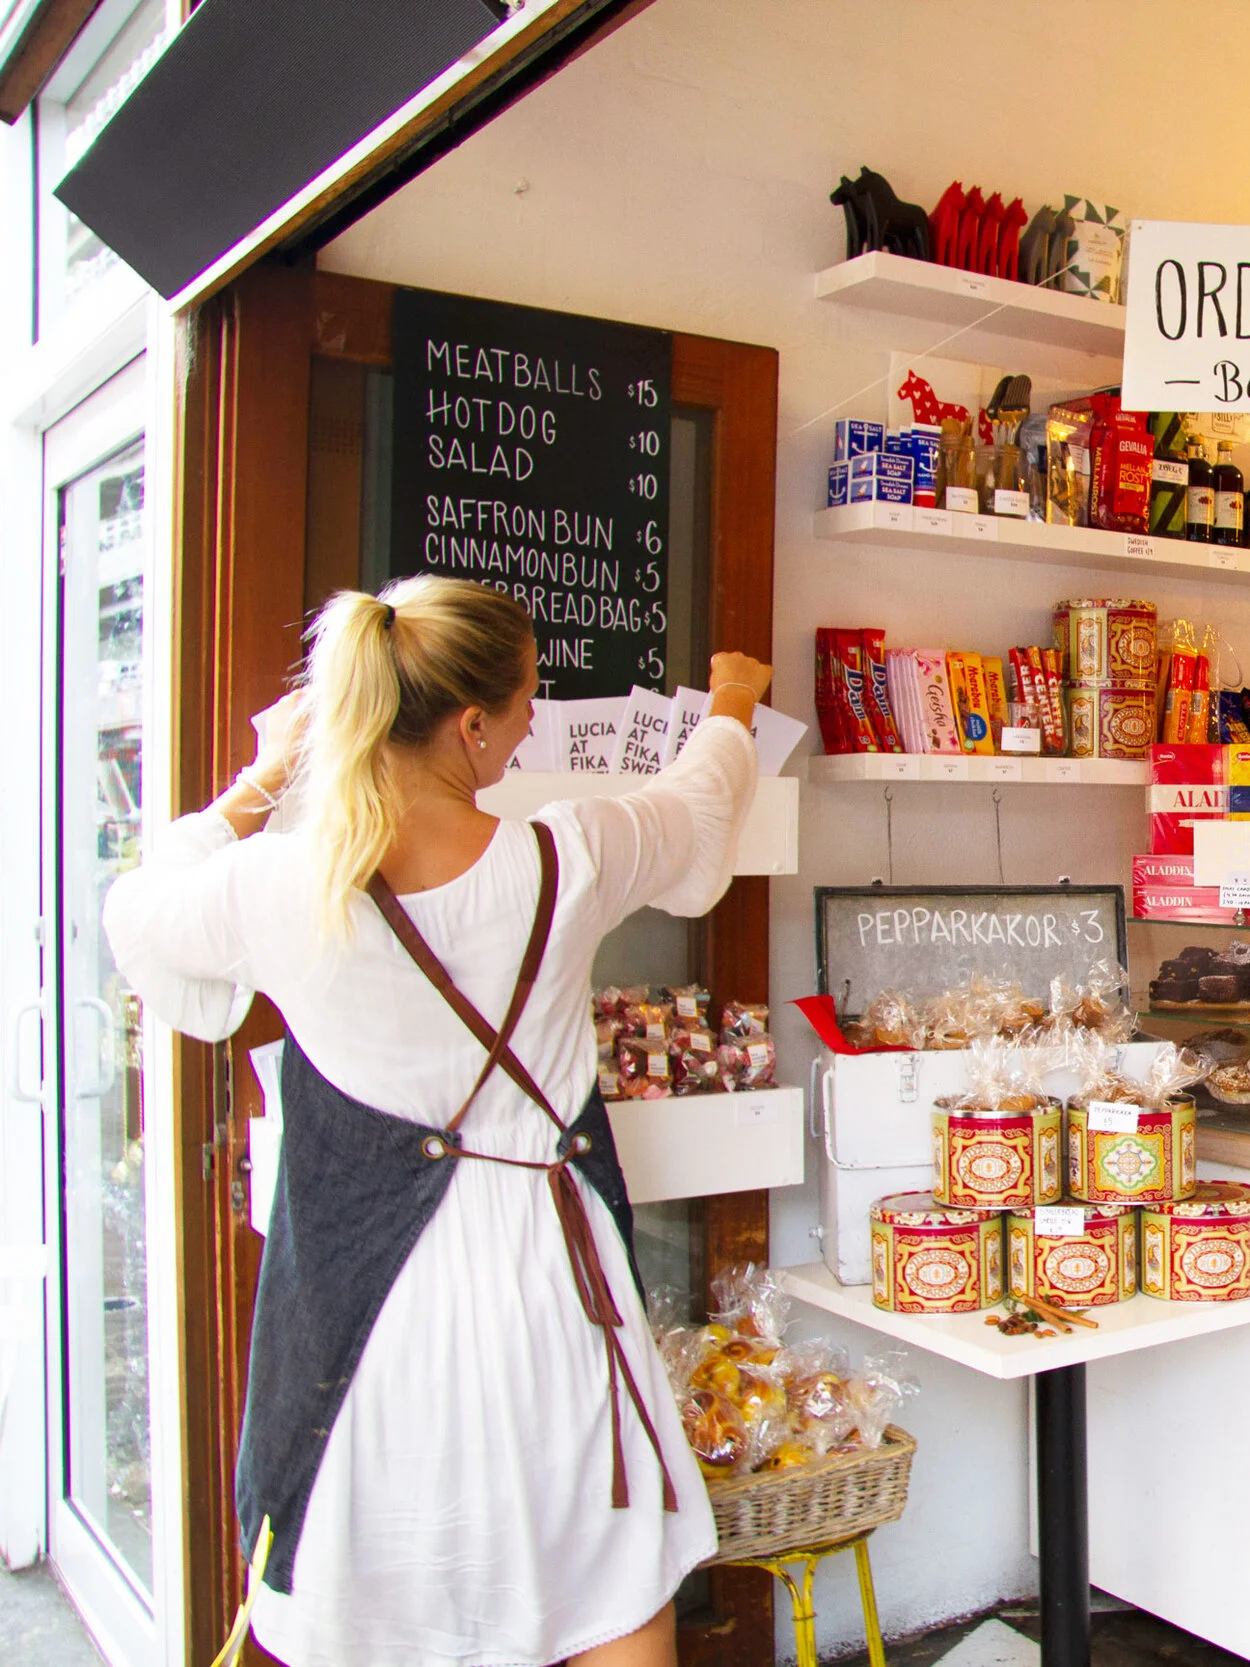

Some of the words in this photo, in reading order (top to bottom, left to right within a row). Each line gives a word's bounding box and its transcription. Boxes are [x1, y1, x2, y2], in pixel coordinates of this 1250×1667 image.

[427, 339, 602, 401] MEATBALLS
[627, 379, 659, 408] $15
[629, 431, 660, 457] $10
[1119, 440, 1148, 456] GEVALIA
[428, 434, 534, 481] SALAD
[628, 473, 658, 500] $10
[894, 463, 907, 471] SALT
[1119, 469, 1146, 484] ROST
[1120, 463, 1147, 474] MELLAN
[427, 495, 546, 543] SAFFRON
[554, 509, 614, 552] BUN
[636, 520, 662, 555] $6
[634, 561, 661, 593] $5
[643, 601, 667, 634] $5
[637, 647, 665, 680] $5
[844, 664, 868, 721] Daim
[869, 657, 891, 718] Daim
[967, 665, 981, 710] Marabou
[988, 671, 1002, 704] Marab
[926, 684, 947, 728] Geisha
[1034, 673, 1055, 736] CENTER
[569, 722, 617, 739] LUCIA
[627, 726, 649, 744] AT
[632, 710, 670, 736] LUCI
[569, 739, 589, 756] AT
[624, 741, 661, 765] FIKA
[570, 755, 609, 772] FIKA
[1145, 865, 1193, 876] ALADDIN
[1145, 896, 1193, 907] ALADDIN
[857, 907, 1062, 949] PEPPARKAKOR
[1070, 909, 1104, 944] $3
